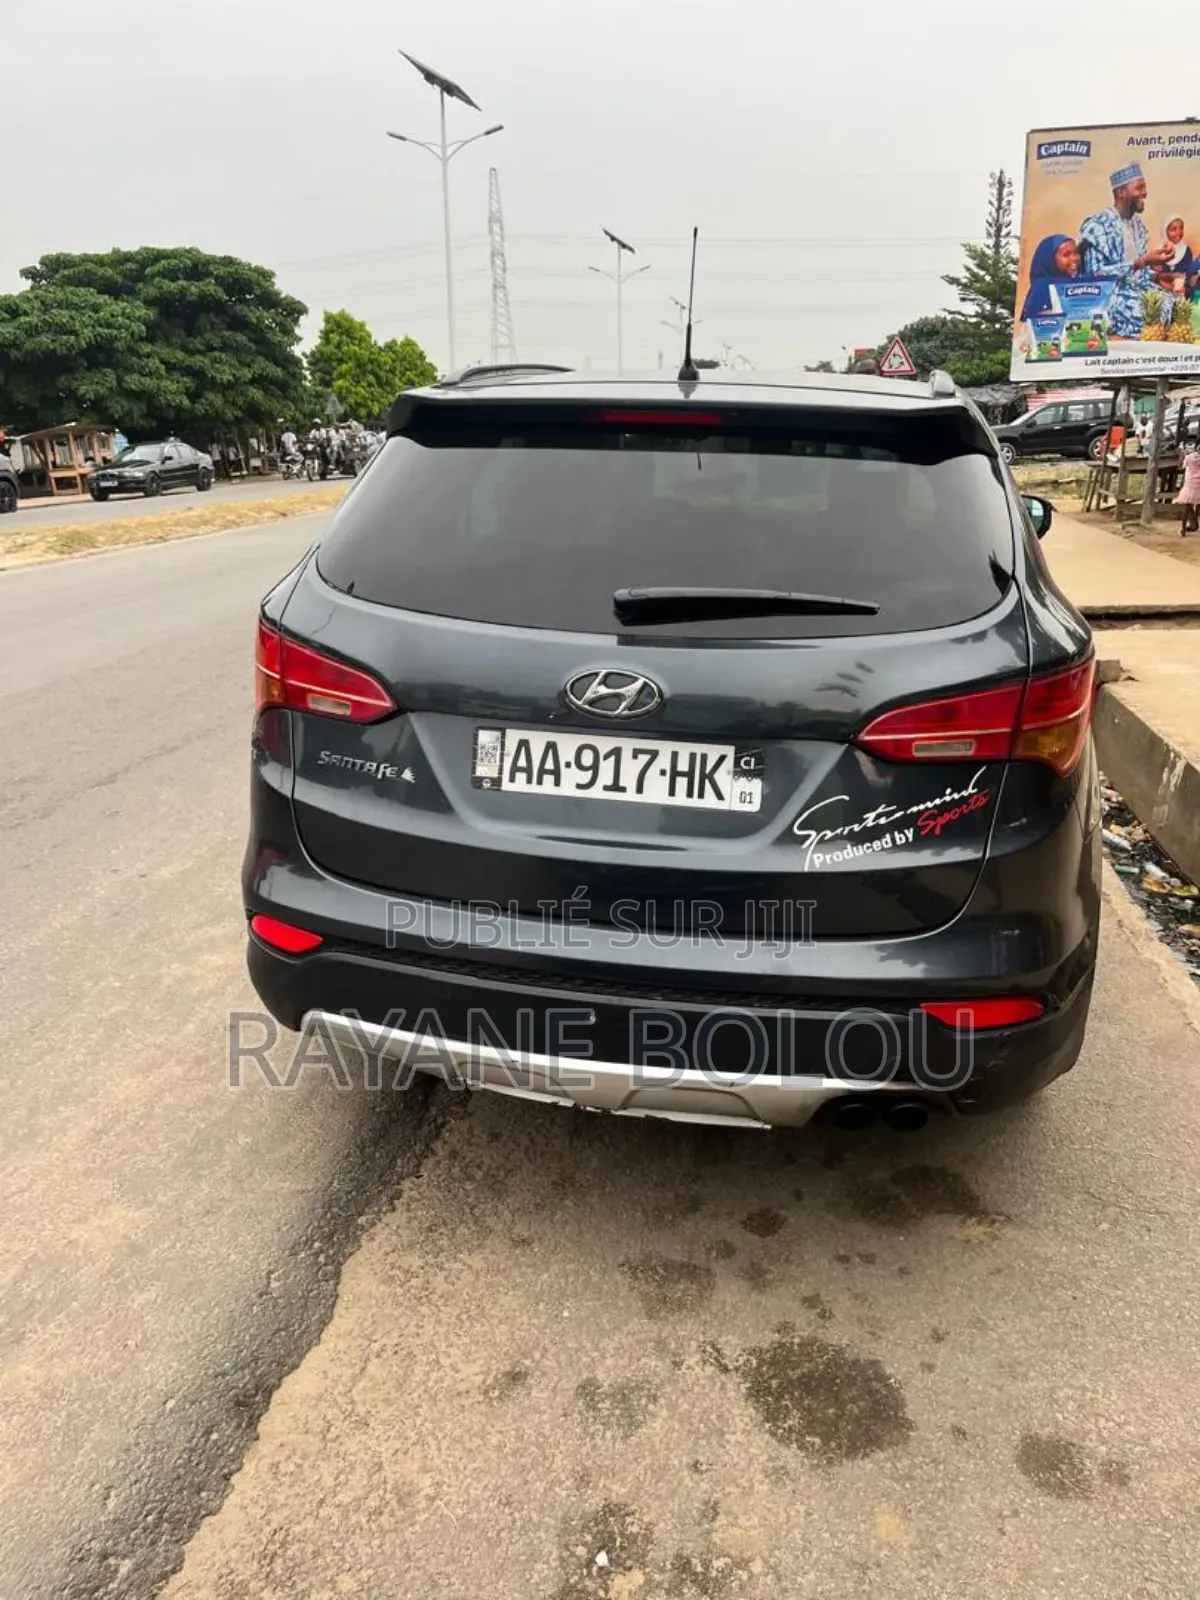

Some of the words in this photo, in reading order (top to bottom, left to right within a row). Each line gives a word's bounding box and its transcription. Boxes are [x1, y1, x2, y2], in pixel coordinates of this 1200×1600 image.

[1127, 136, 1165, 146] Avant,
[1168, 133, 1200, 146] pend
[1041, 142, 1088, 156] Captain
[1067, 286, 1100, 296] Captain
[1102, 357, 1134, 366] captain
[740, 756, 755, 770] CI
[813, 833, 892, 868] Produced
[894, 827, 914, 846] by
[916, 788, 991, 837] Sports
